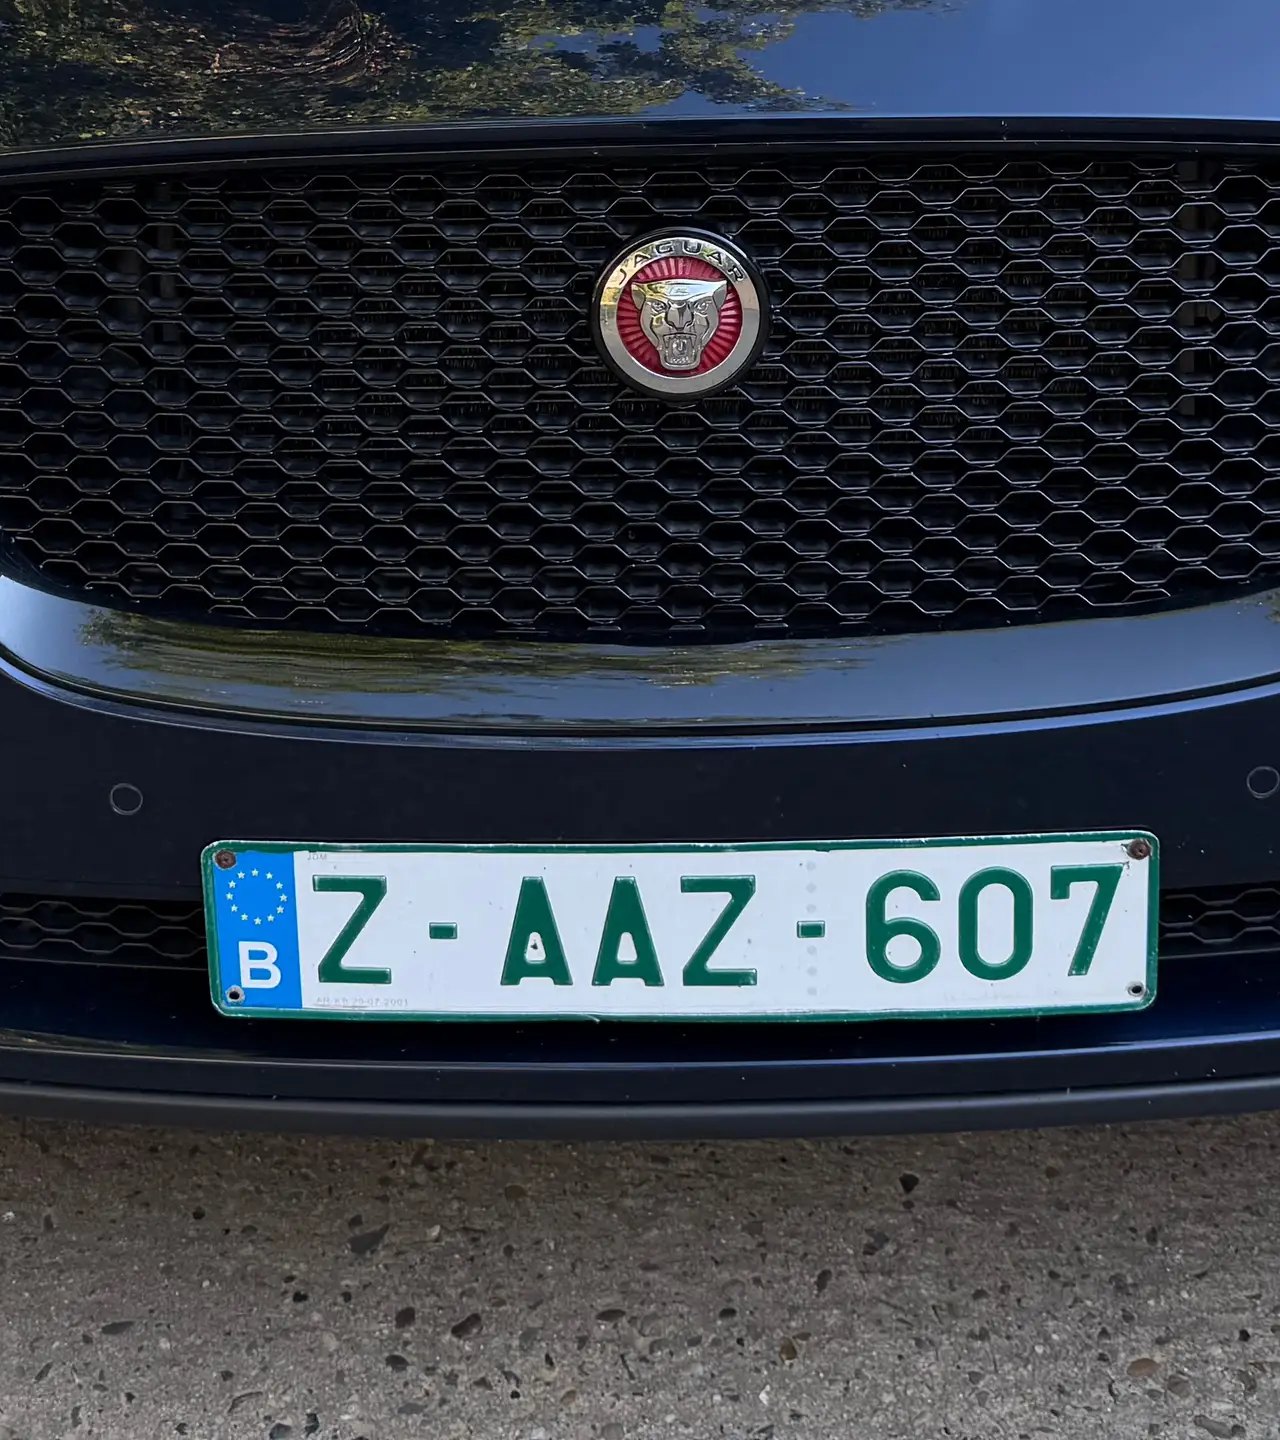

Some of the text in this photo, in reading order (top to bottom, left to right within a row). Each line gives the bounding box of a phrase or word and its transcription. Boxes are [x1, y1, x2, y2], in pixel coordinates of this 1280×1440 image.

[617, 241, 745, 285] JAGUAR
[312, 863, 1125, 986] Z-AAZ-607
[238, 940, 282, 989] B
